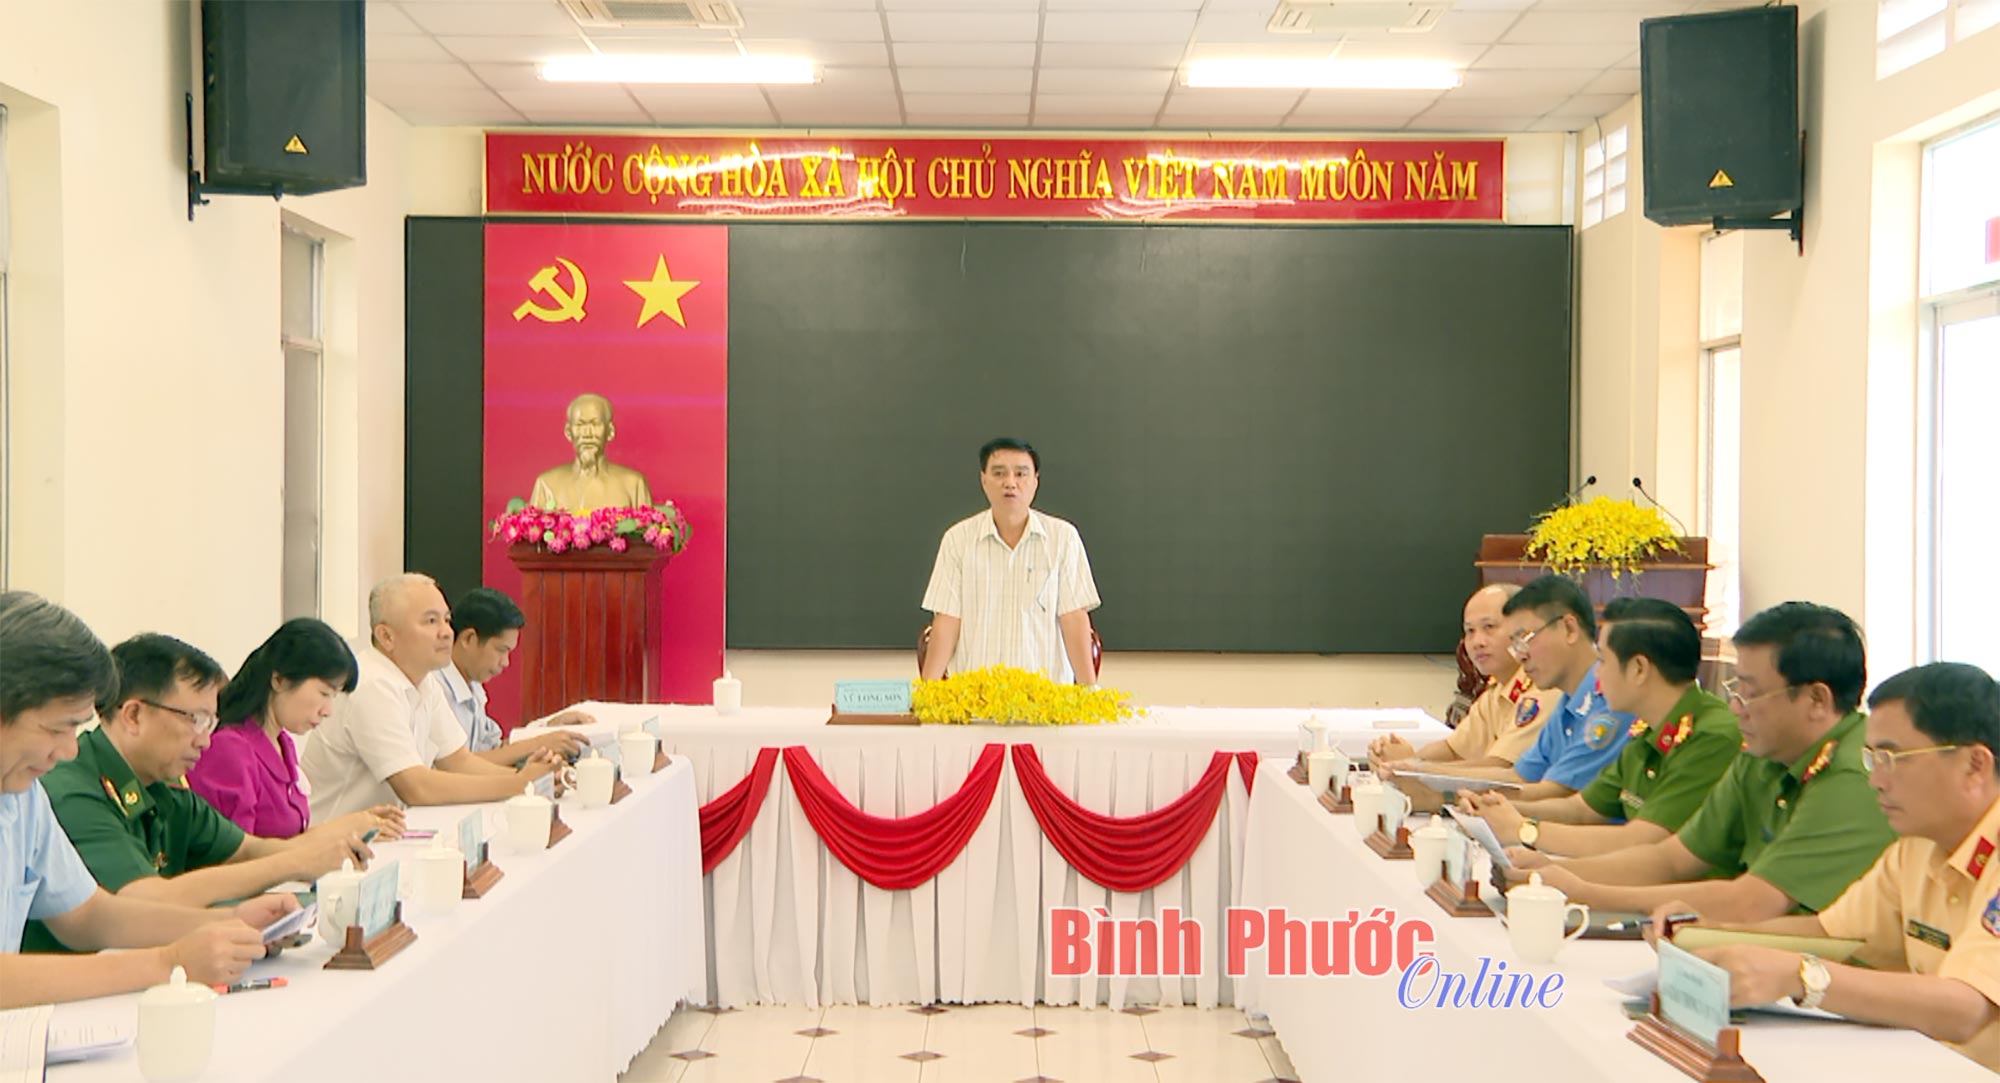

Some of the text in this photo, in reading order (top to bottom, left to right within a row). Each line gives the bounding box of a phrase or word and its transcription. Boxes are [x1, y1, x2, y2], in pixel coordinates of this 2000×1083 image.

[521, 141, 1479, 209] NƯỚC CỘNG HÒA XÃ HỘI CHỦ NGHĨA VIỆT NAM MUÔN NĂM
